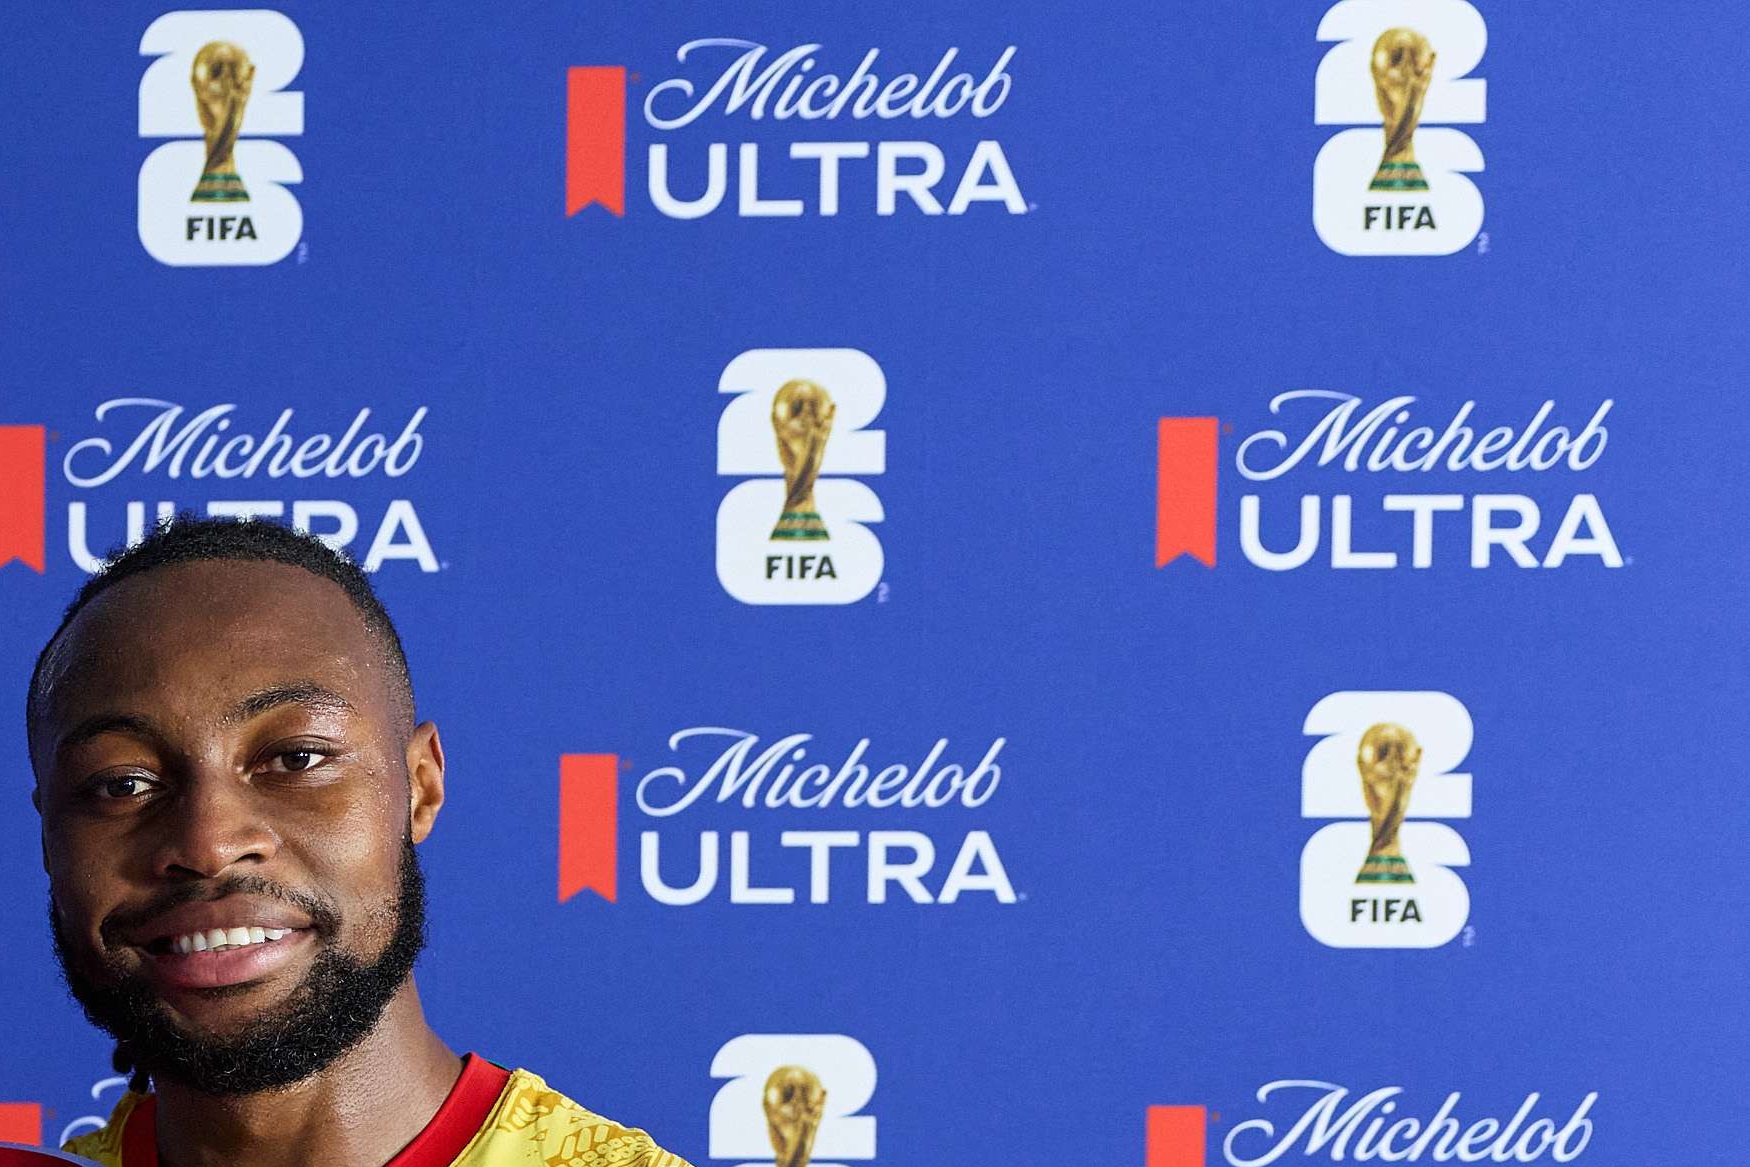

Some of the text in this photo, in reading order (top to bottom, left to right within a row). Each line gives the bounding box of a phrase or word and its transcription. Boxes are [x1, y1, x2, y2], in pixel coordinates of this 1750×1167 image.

[644, 38, 1018, 131] Michelob
[649, 141, 1030, 221] ULTRA
[1364, 205, 1436, 230] FIFA
[186, 216, 258, 241] FIFA
[64, 398, 429, 489] Michelob
[1236, 390, 1615, 482] Michelob
[766, 555, 837, 580] FIFA
[1240, 494, 1625, 573] ULTRA
[636, 727, 1008, 819] Michelob
[641, 831, 1019, 907] ULTRA
[1351, 898, 1422, 923] FIFA
